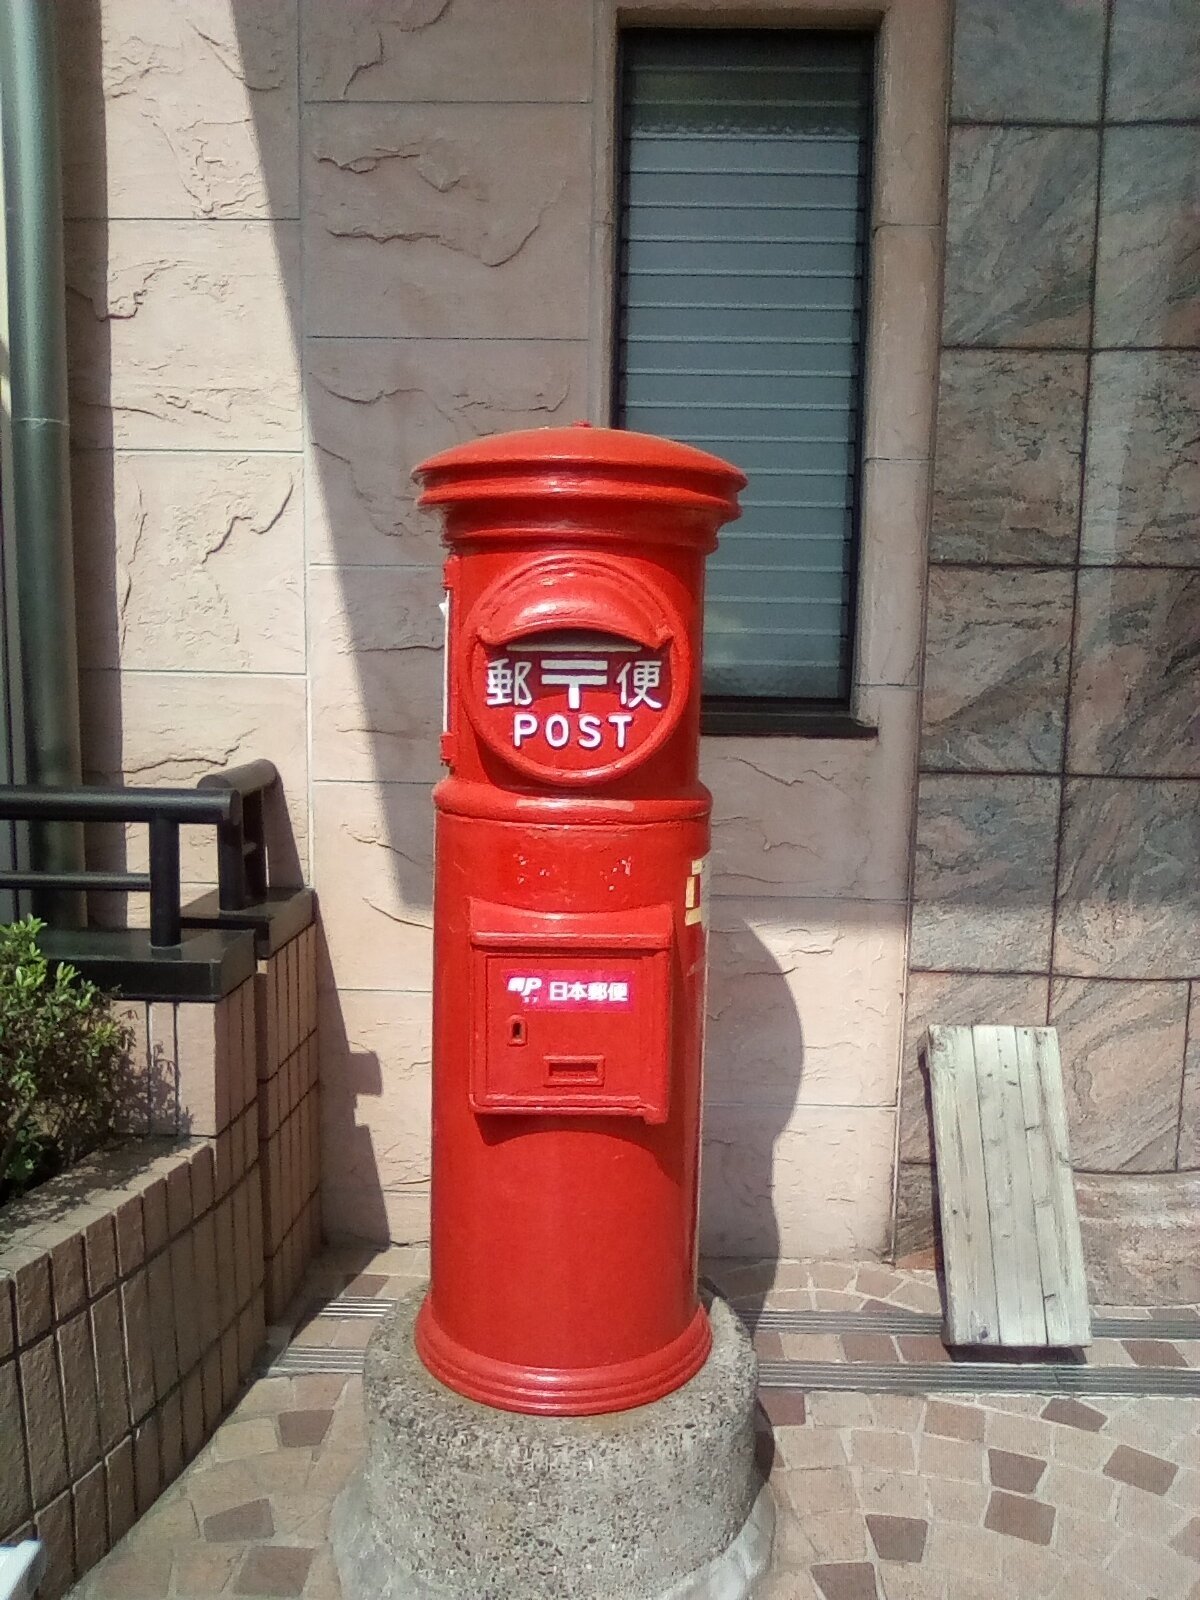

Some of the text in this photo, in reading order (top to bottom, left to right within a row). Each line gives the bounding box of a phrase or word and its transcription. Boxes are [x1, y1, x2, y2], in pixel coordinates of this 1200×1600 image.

[512, 712, 633, 748] POST
[548, 979, 629, 1003] 日本郵便
